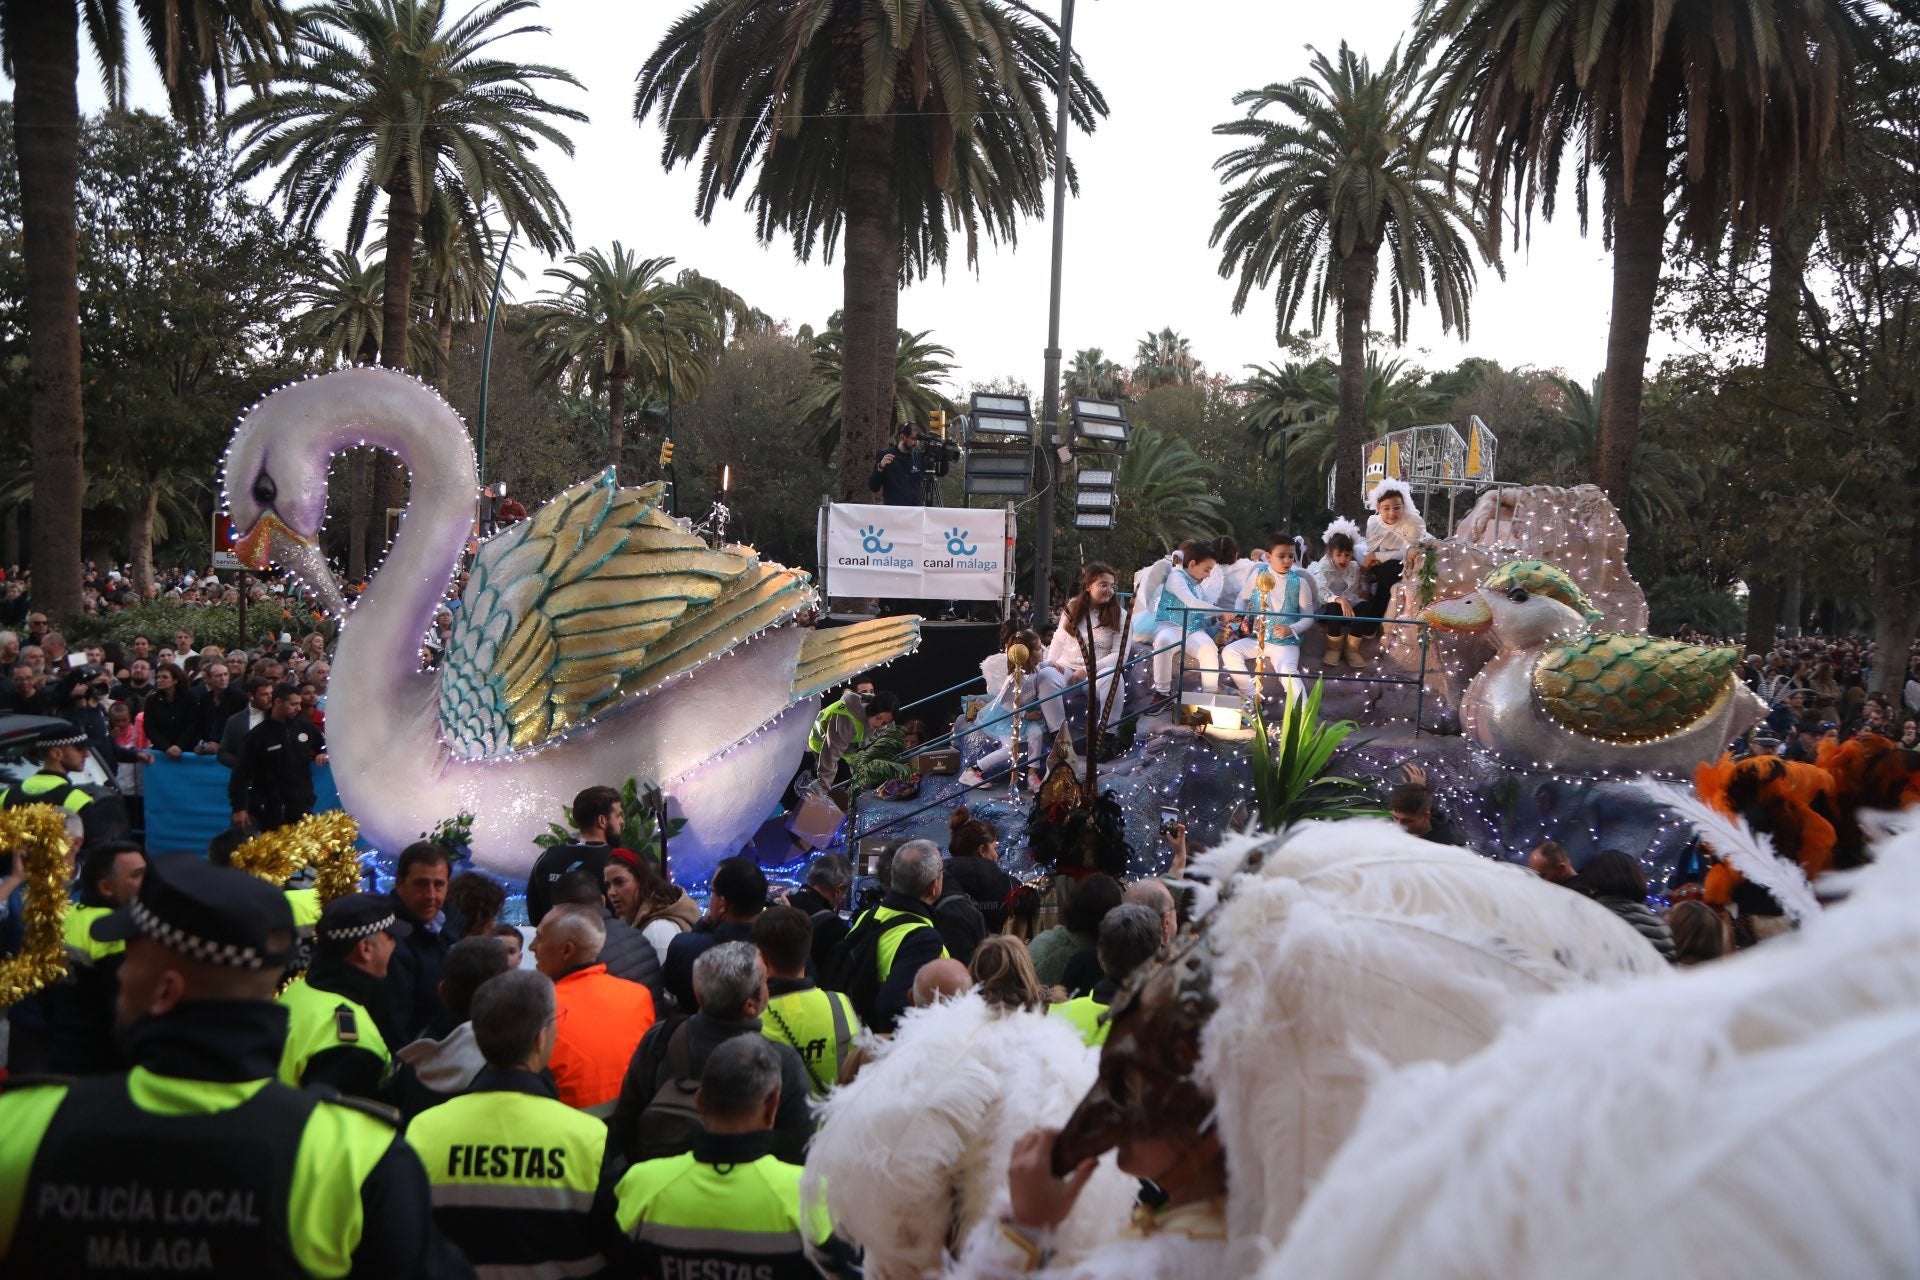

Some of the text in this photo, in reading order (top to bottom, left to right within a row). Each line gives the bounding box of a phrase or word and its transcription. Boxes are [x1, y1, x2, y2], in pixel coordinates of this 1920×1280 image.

[838, 556, 914, 569] canal málaga
[923, 557, 998, 571] canal málaga
[447, 1144, 566, 1180] FIESTAS
[36, 1180, 261, 1225] POLICÍA LOCAL
[86, 1228, 214, 1271] MÁLAGA
